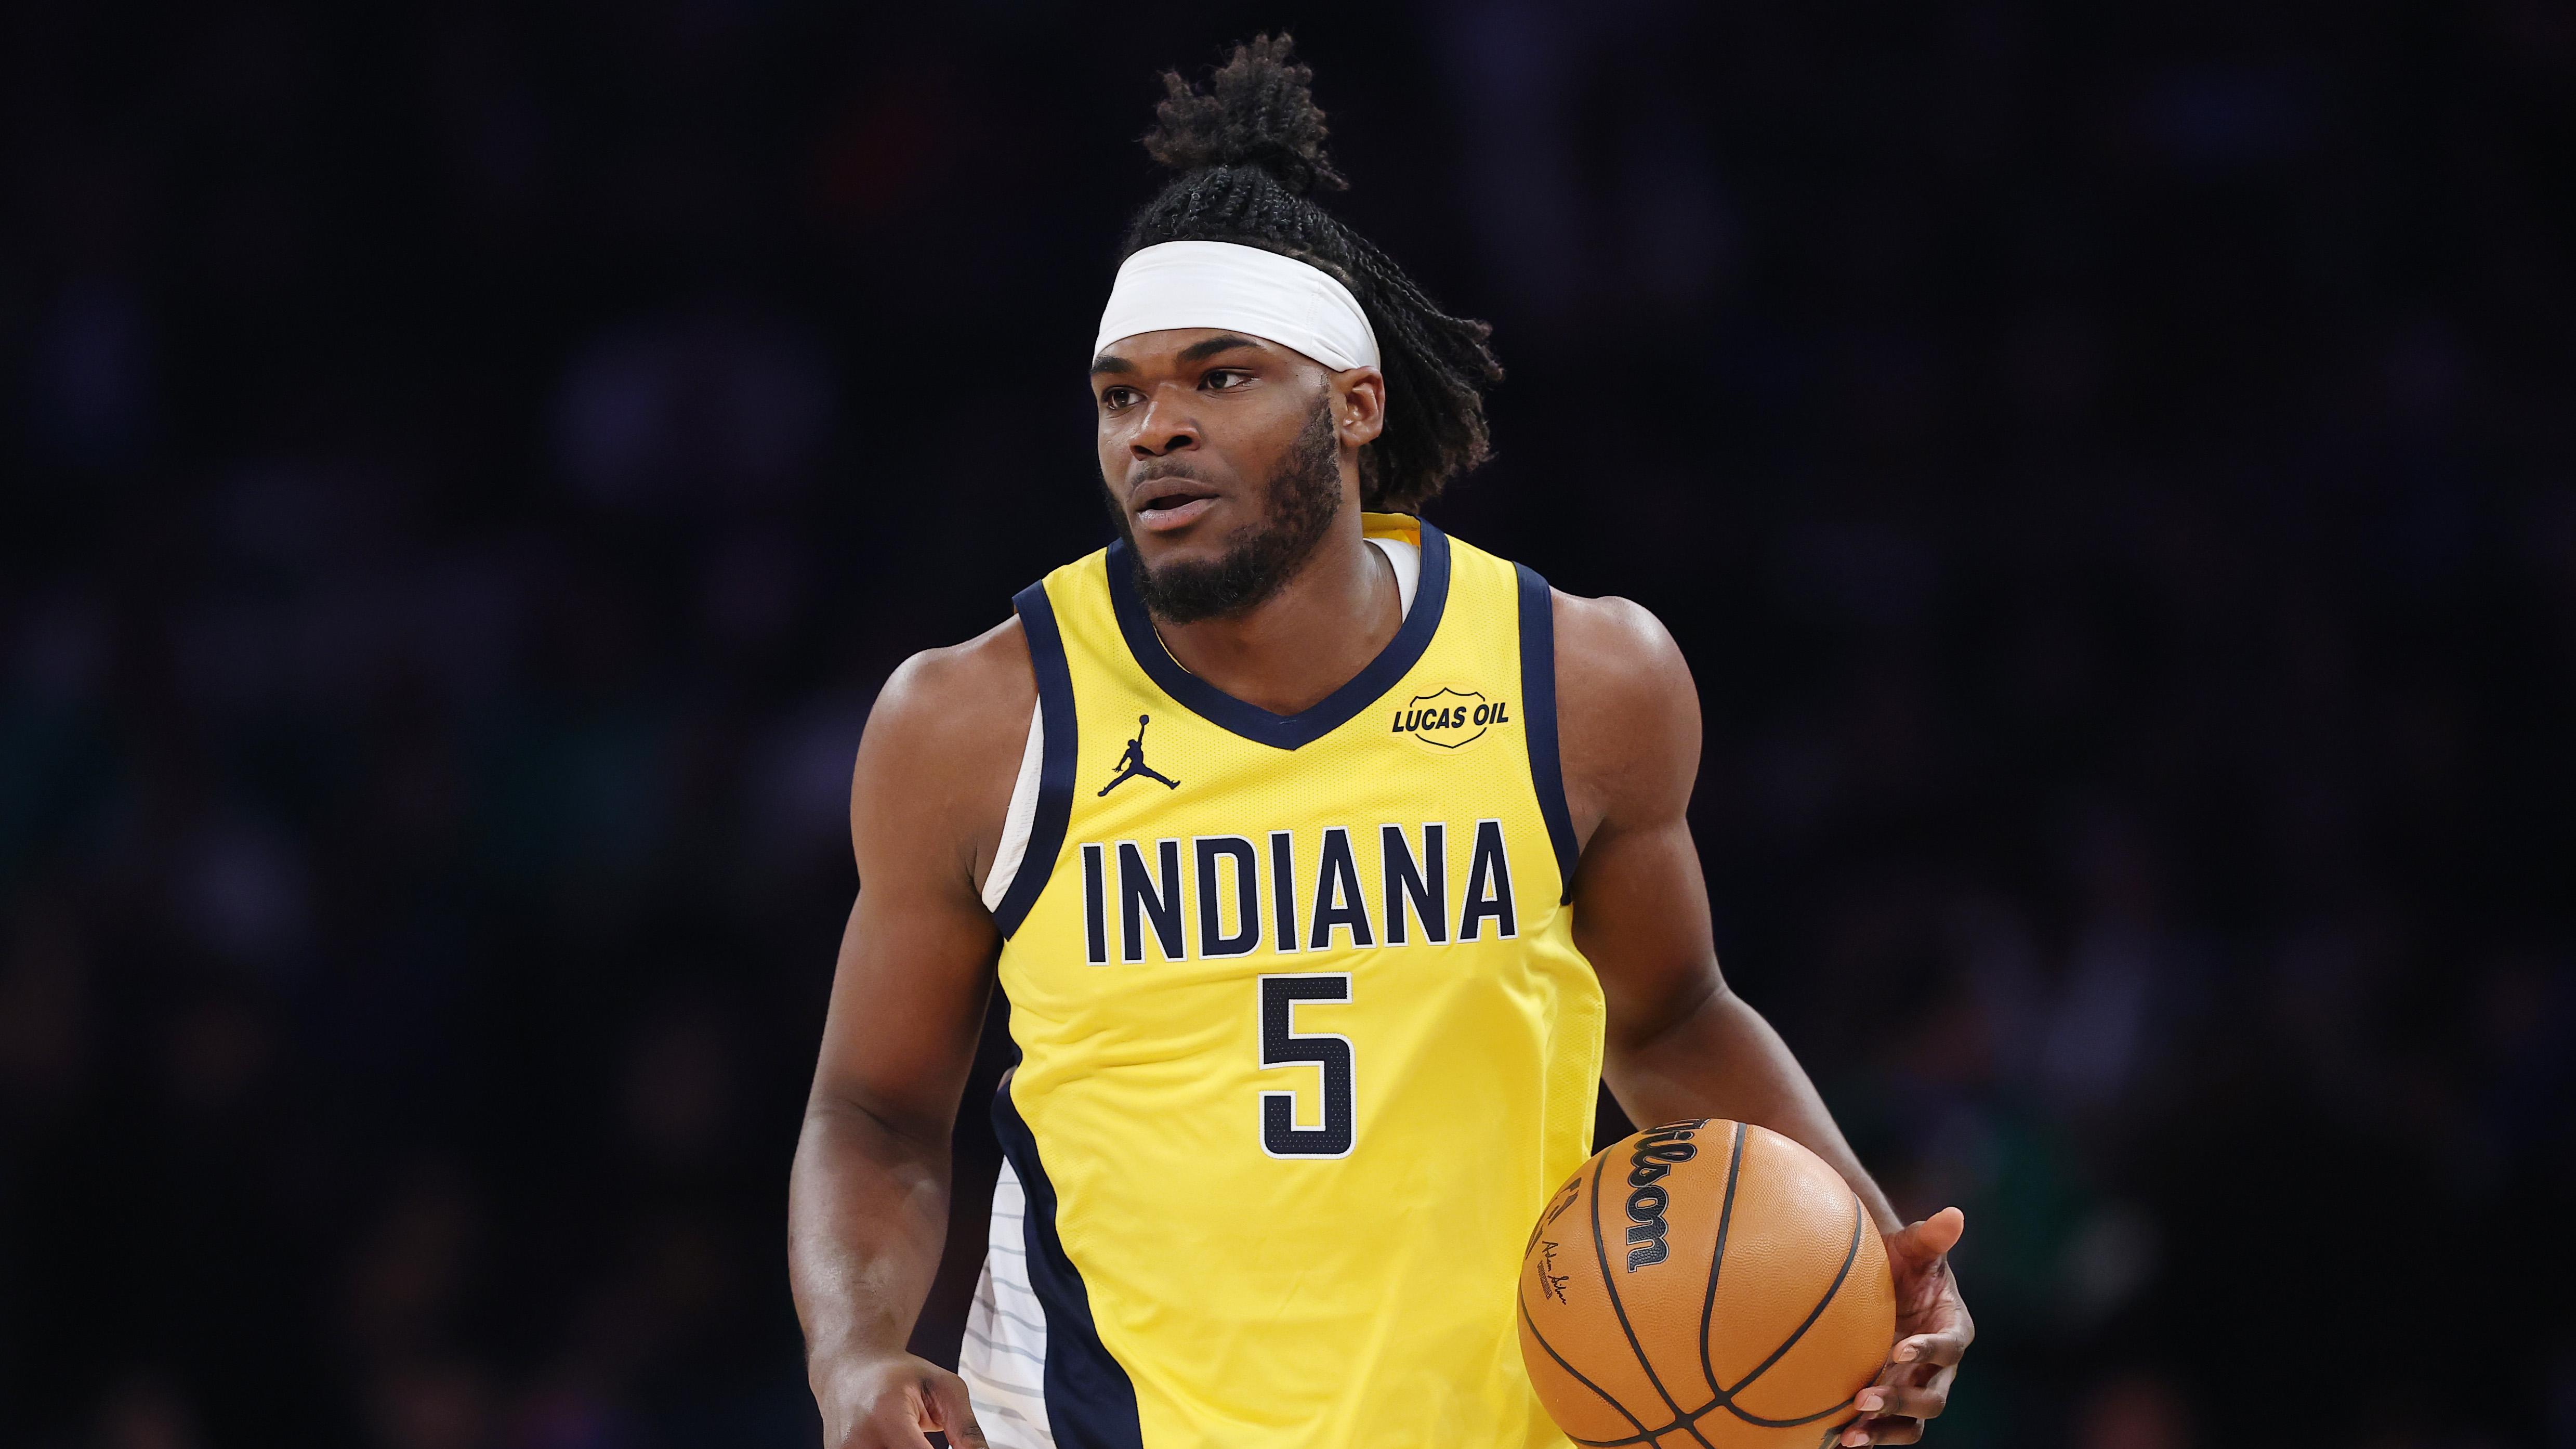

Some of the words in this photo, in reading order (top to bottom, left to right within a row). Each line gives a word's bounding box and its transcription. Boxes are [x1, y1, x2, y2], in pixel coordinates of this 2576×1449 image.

[1392, 706, 1467, 733] LUCAS
[1473, 702, 1508, 725] OIL
[1080, 818, 1518, 967] INDIANA
[1257, 971, 1357, 1159] 5
